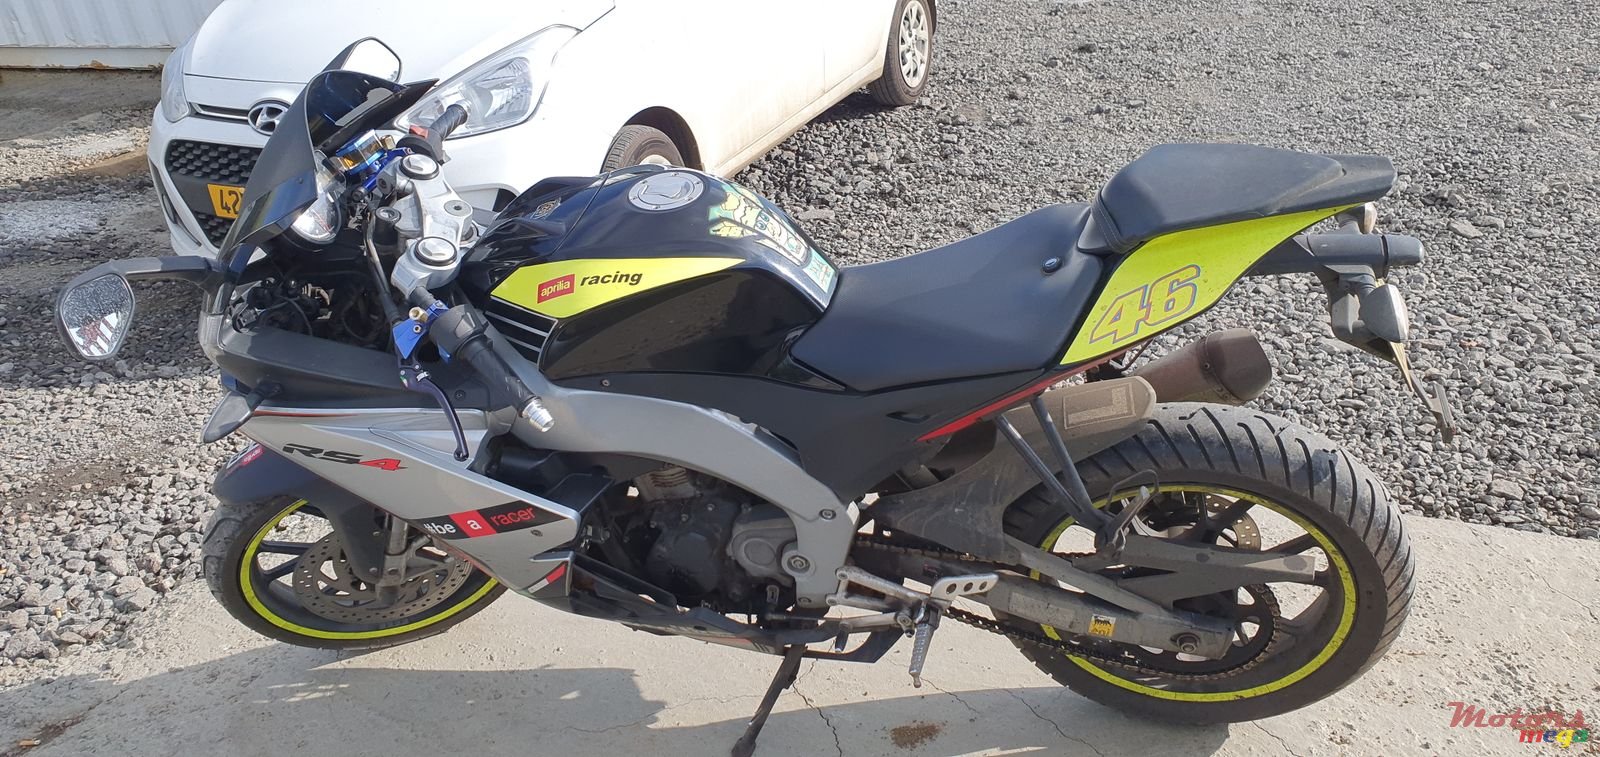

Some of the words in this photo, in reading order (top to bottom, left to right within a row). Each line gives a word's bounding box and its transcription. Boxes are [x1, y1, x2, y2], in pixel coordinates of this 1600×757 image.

[220, 189, 243, 214] 42
[540, 280, 571, 297] aprilia
[580, 271, 643, 286] racing
[1089, 264, 1200, 344] 46
[282, 443, 408, 471] RS4
[423, 522, 457, 534] #be
[466, 519, 482, 530] a
[490, 507, 536, 526] racer
